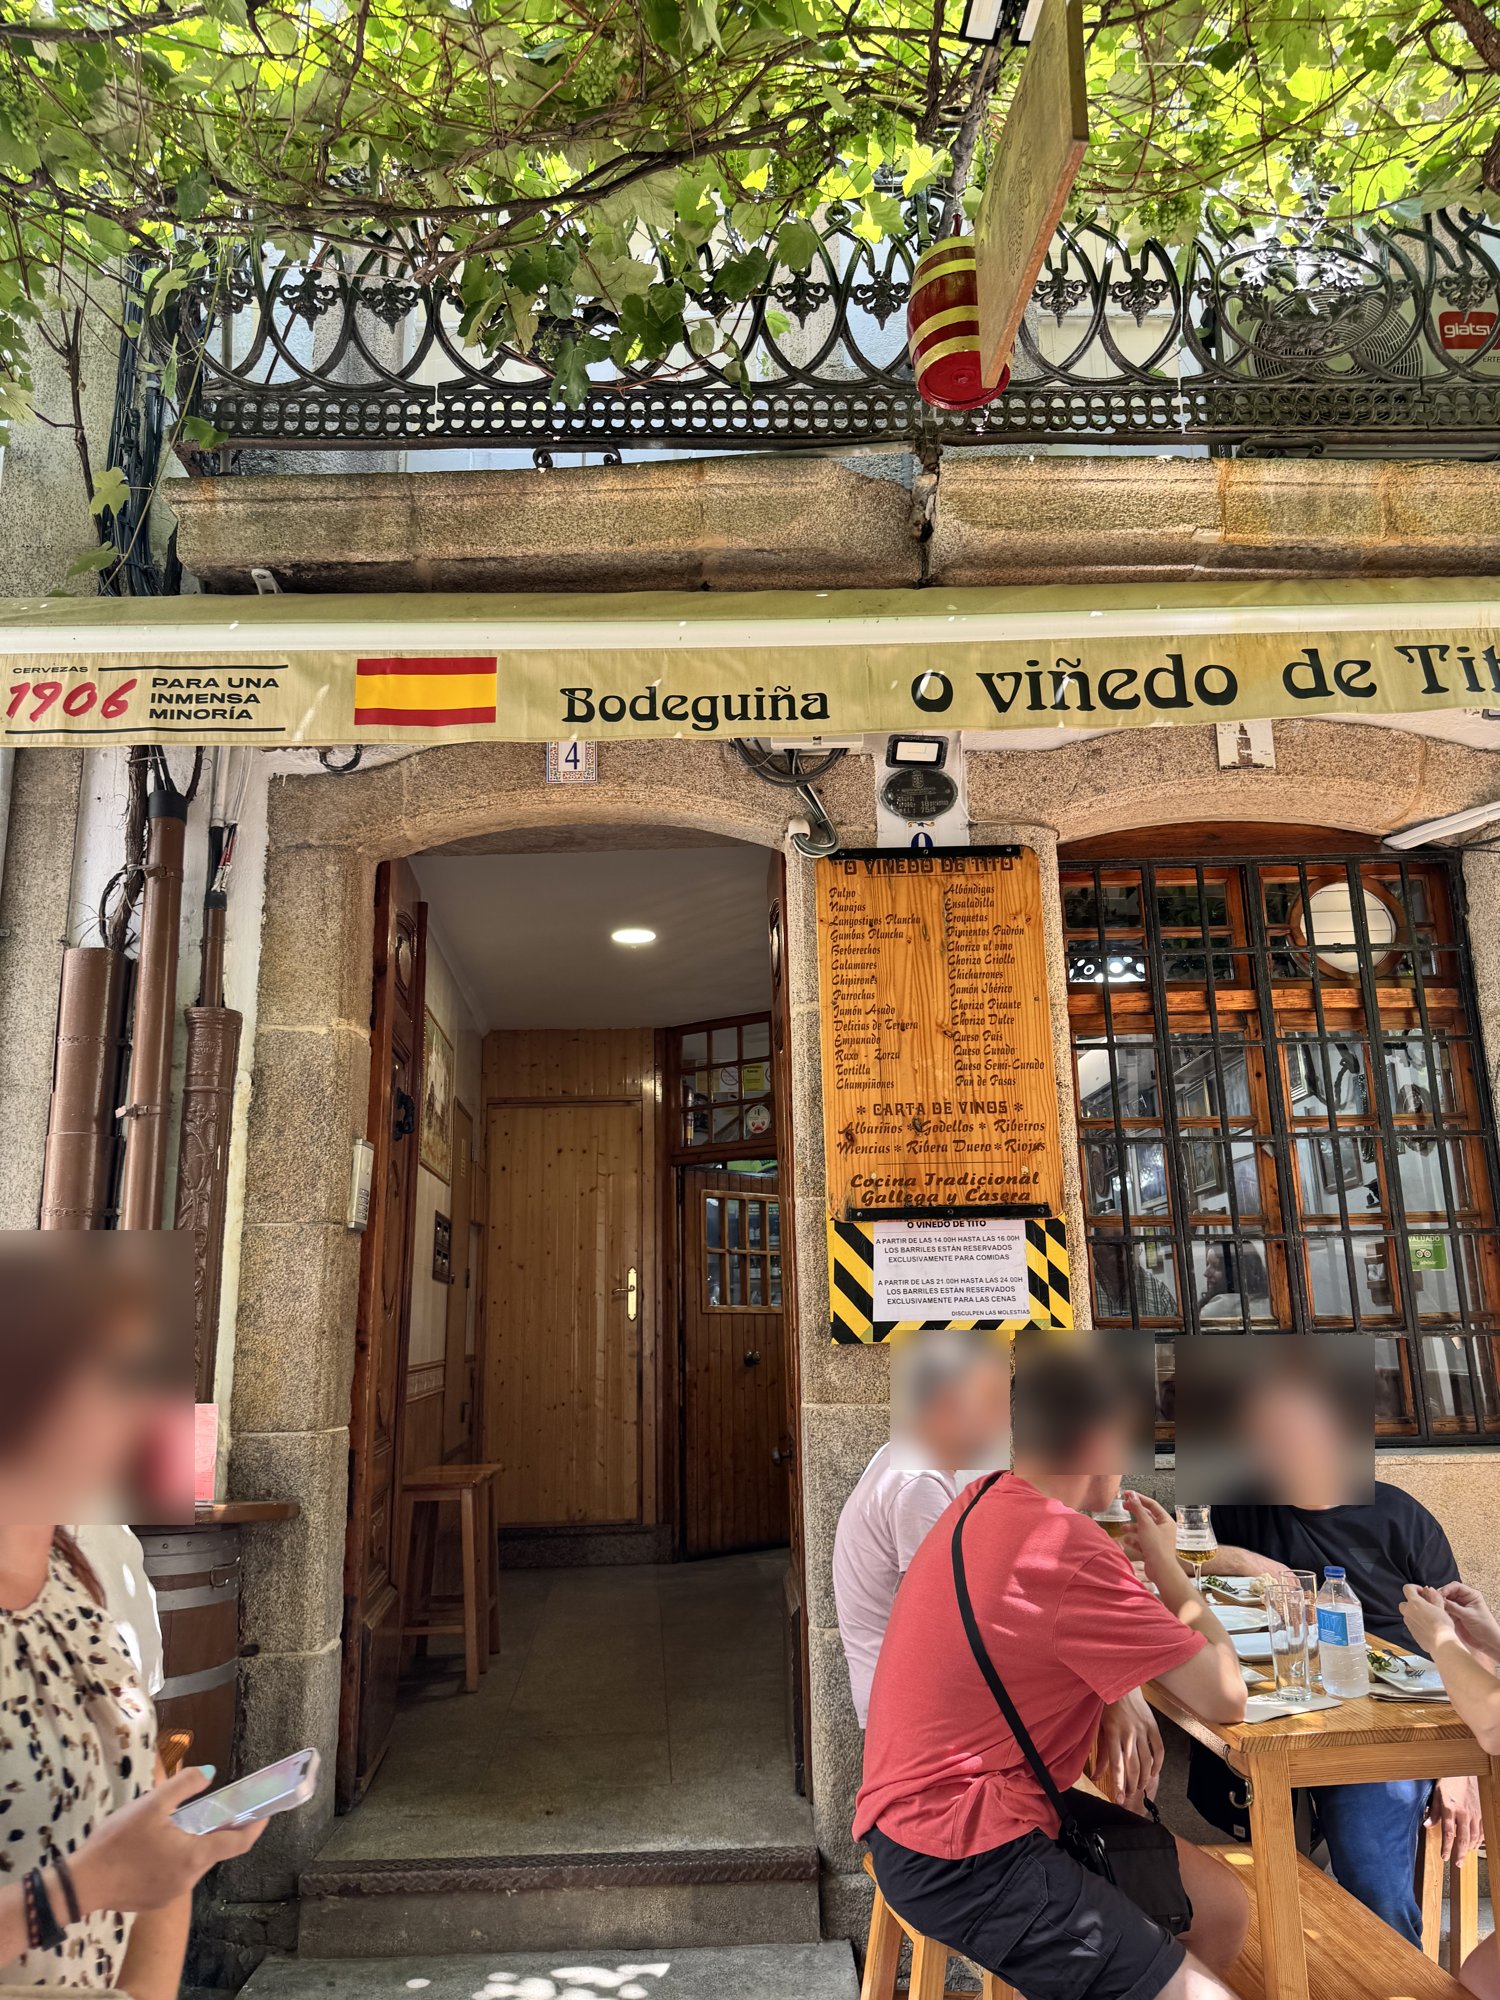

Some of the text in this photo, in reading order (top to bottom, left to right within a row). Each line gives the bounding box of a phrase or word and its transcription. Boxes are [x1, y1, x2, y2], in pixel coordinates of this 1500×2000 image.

[12, 666, 88, 674] CERVEZAS
[152, 677, 279, 688] PARA UNA
[976, 653, 1238, 713] viñedo
[1282, 648, 1377, 699] de
[6, 678, 137, 722] 1906
[150, 693, 261, 704] INMENSA
[149, 706, 253, 720] MINORÍA
[559, 684, 831, 732] Bodeguiña
[565, 741, 579, 770] 4
[941, 857, 965, 872] DE
[829, 887, 856, 900] Pulpo
[944, 884, 995, 896] Albóndigas
[829, 901, 866, 914] Navajas
[945, 898, 995, 911] Ensaladilla
[829, 913, 920, 928] Langostinos Plancha
[946, 912, 988, 924] Croquetas
[830, 928, 904, 942] Gambas Plancha
[946, 924, 1024, 938] Pimientos Padrón
[831, 944, 880, 956] Berberechos
[946, 940, 980, 952] Chorizo
[983, 940, 992, 951] al
[832, 960, 878, 970] Calamares
[948, 954, 1015, 966] Chorizo Criollo
[948, 968, 1004, 980] Chicharrones
[832, 974, 878, 988] Chipirones
[832, 989, 876, 1000] Parrochas
[950, 982, 1012, 997] Jamón Ibérico
[950, 998, 1022, 1010] Chorizo Picante
[834, 1004, 896, 1018] Jamón Asado
[834, 1020, 870, 1032] Delicias
[872, 1020, 882, 1030] de
[952, 1014, 1014, 1026] Chorizo Dulce
[952, 1029, 1003, 1041] Queso País
[835, 1049, 859, 1062] Raxo
[954, 1044, 1016, 1056] Queso Curado
[836, 1064, 870, 1076] Tortilla
[954, 1058, 1044, 1070] Queso Semi-Curado
[836, 1078, 894, 1092] Champiñones
[955, 1074, 1016, 1086] Pan de Pasas
[873, 1101, 1008, 1116] CARTA DE VINOS
[838, 1118, 1045, 1136] Albariños Godellos Ribeiros
[906, 1140, 948, 1154] Ribera
[952, 1140, 992, 1153] Duero
[850, 1172, 1040, 1188] Cocina Tradicional
[861, 1189, 1030, 1206] Gallega y Casera
[953, 1220, 965, 1228] DE
[963, 1244, 1012, 1252] RESERVADOS
[886, 1288, 901, 1296] LOS
[888, 1297, 952, 1305] EXCLUSIVAMENTE
[954, 1296, 974, 1304] PARA
